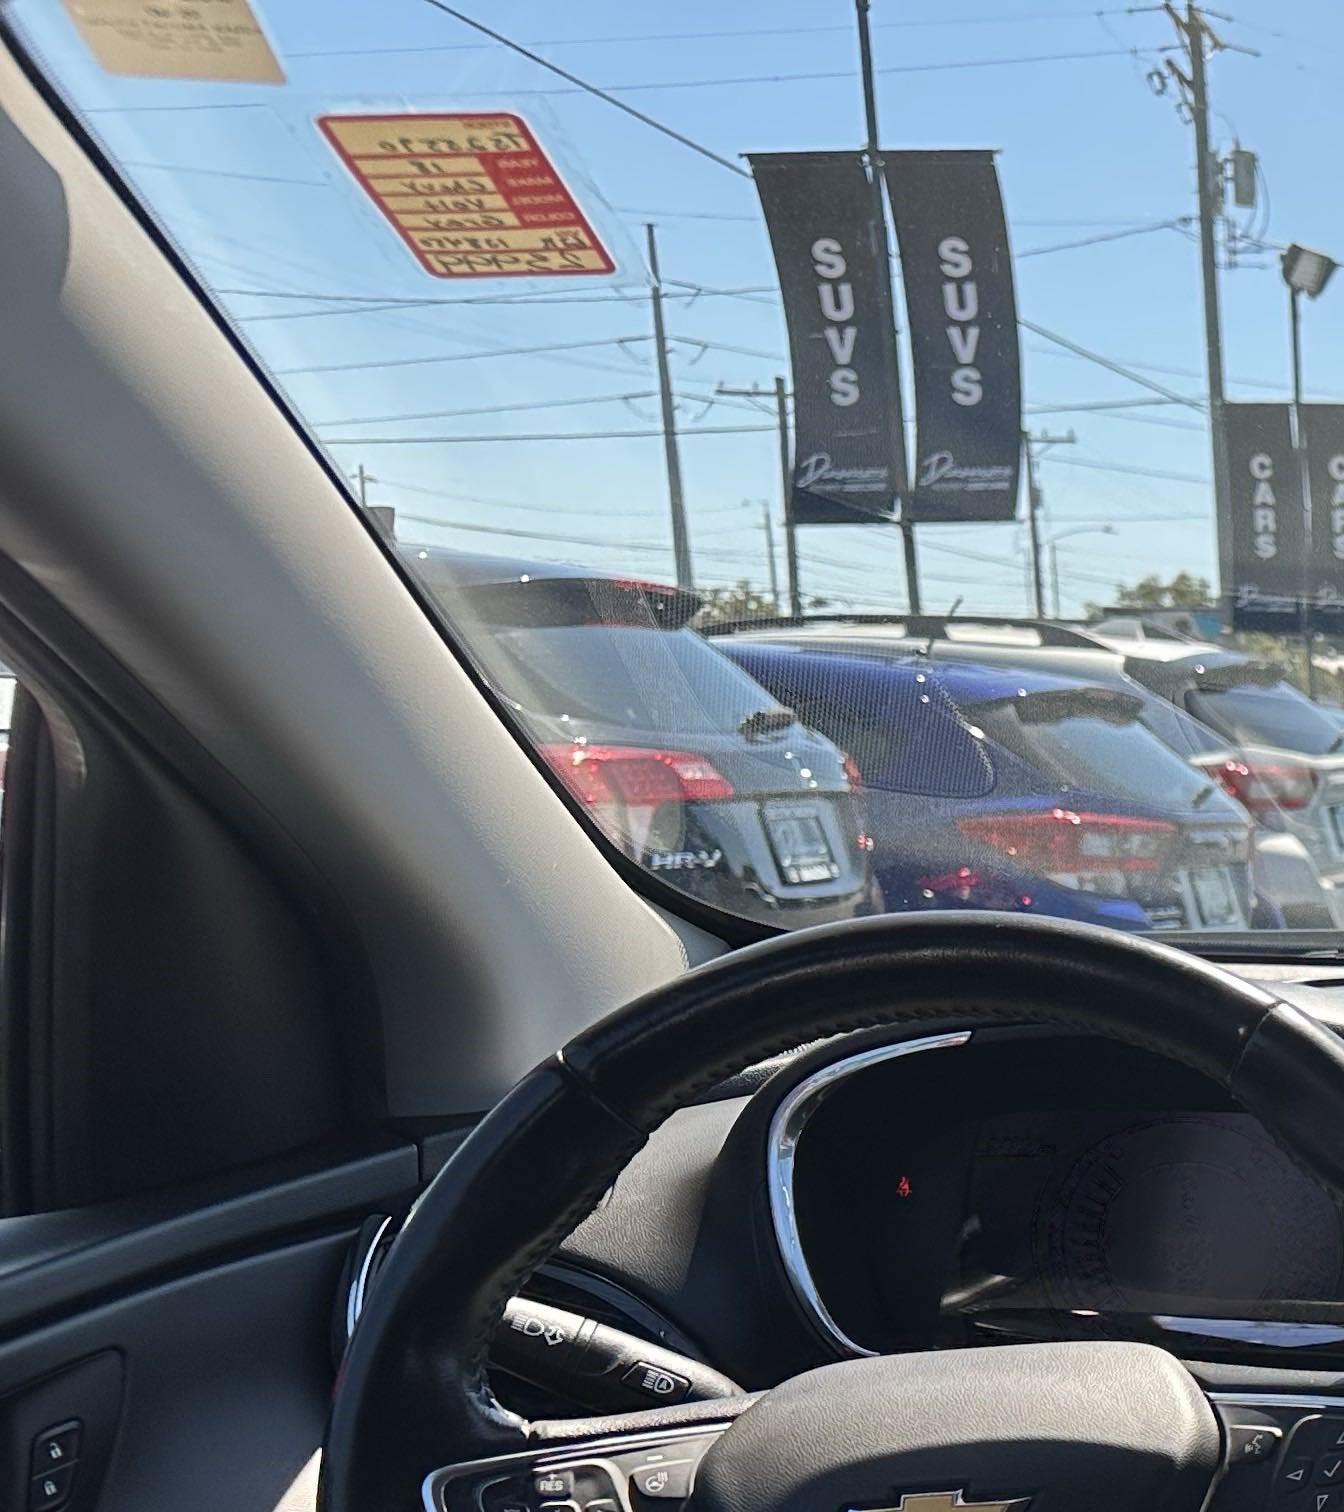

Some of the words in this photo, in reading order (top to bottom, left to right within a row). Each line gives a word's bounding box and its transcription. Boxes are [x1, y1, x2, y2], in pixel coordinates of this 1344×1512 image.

[811, 237, 860, 408] SUVS
[938, 236, 984, 406] SUVS
[1249, 453, 1276, 560] CARS
[650, 848, 722, 871] HR-V
